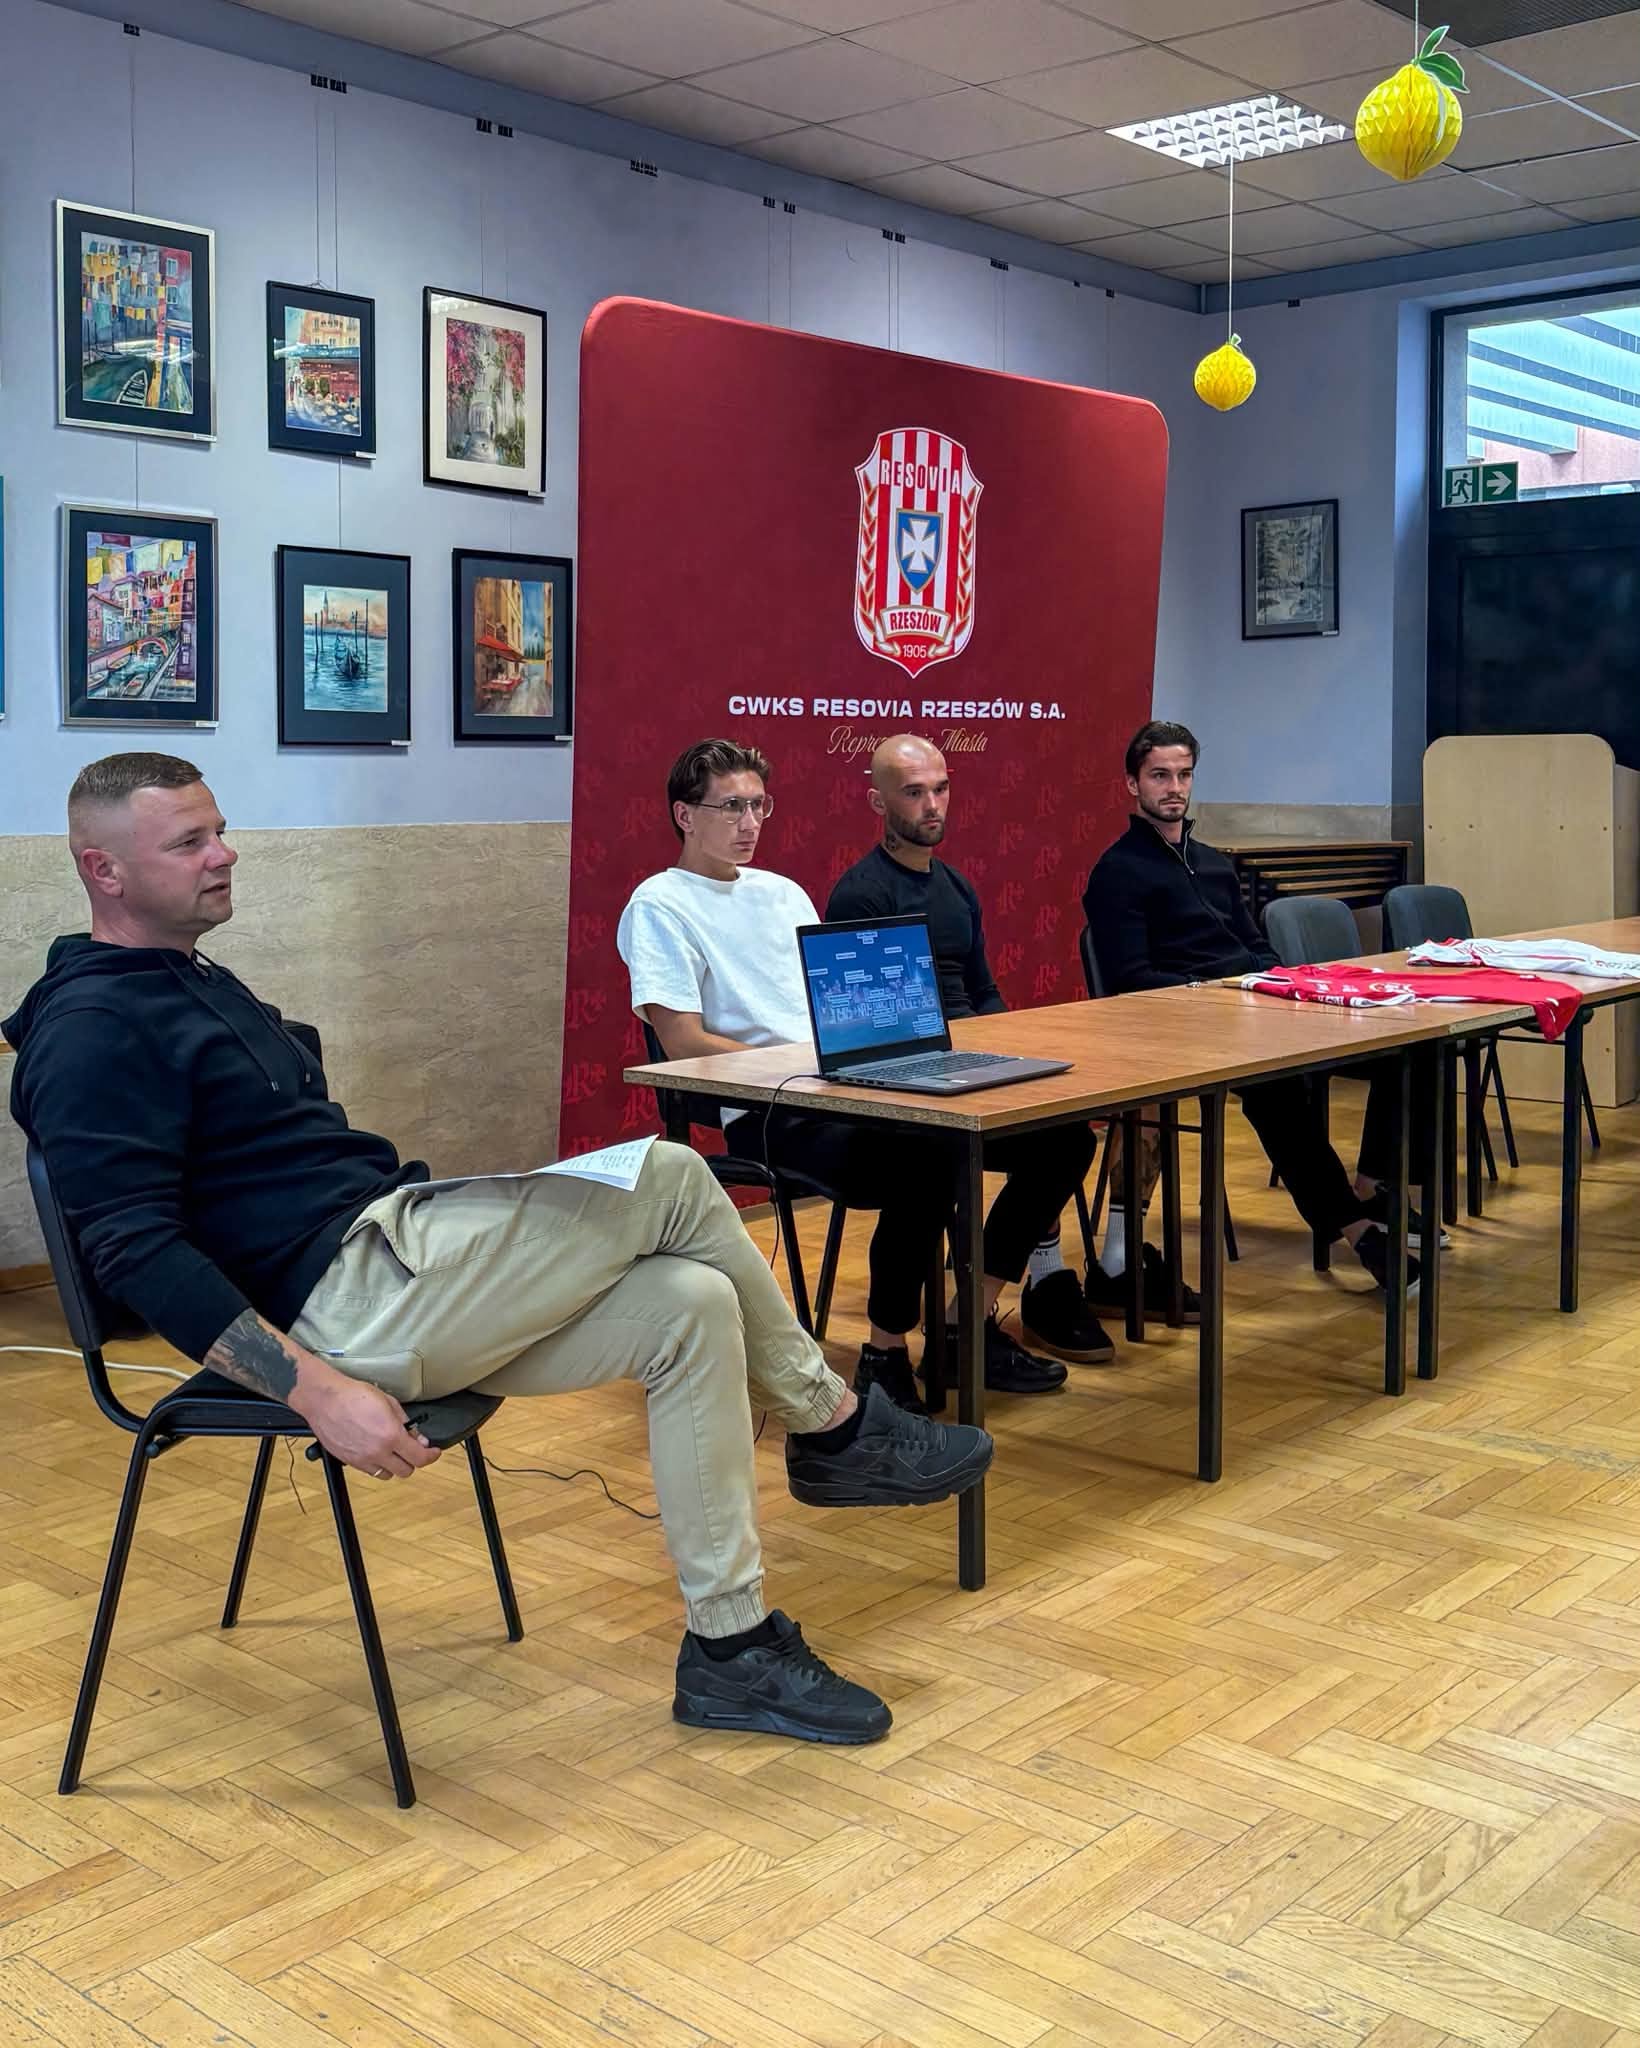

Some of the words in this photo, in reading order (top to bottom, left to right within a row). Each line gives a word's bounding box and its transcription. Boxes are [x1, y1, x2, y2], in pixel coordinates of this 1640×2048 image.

[880, 459, 961, 495] RESOVIA
[890, 608, 942, 633] RZESZÓW
[902, 644, 927, 658] 1905
[728, 695, 805, 716] CWKS
[813, 698, 913, 718] RESOVIA
[921, 697, 1024, 719] RZESZÓW
[1030, 702, 1066, 719] S.A.
[940, 727, 989, 752] Miasta
